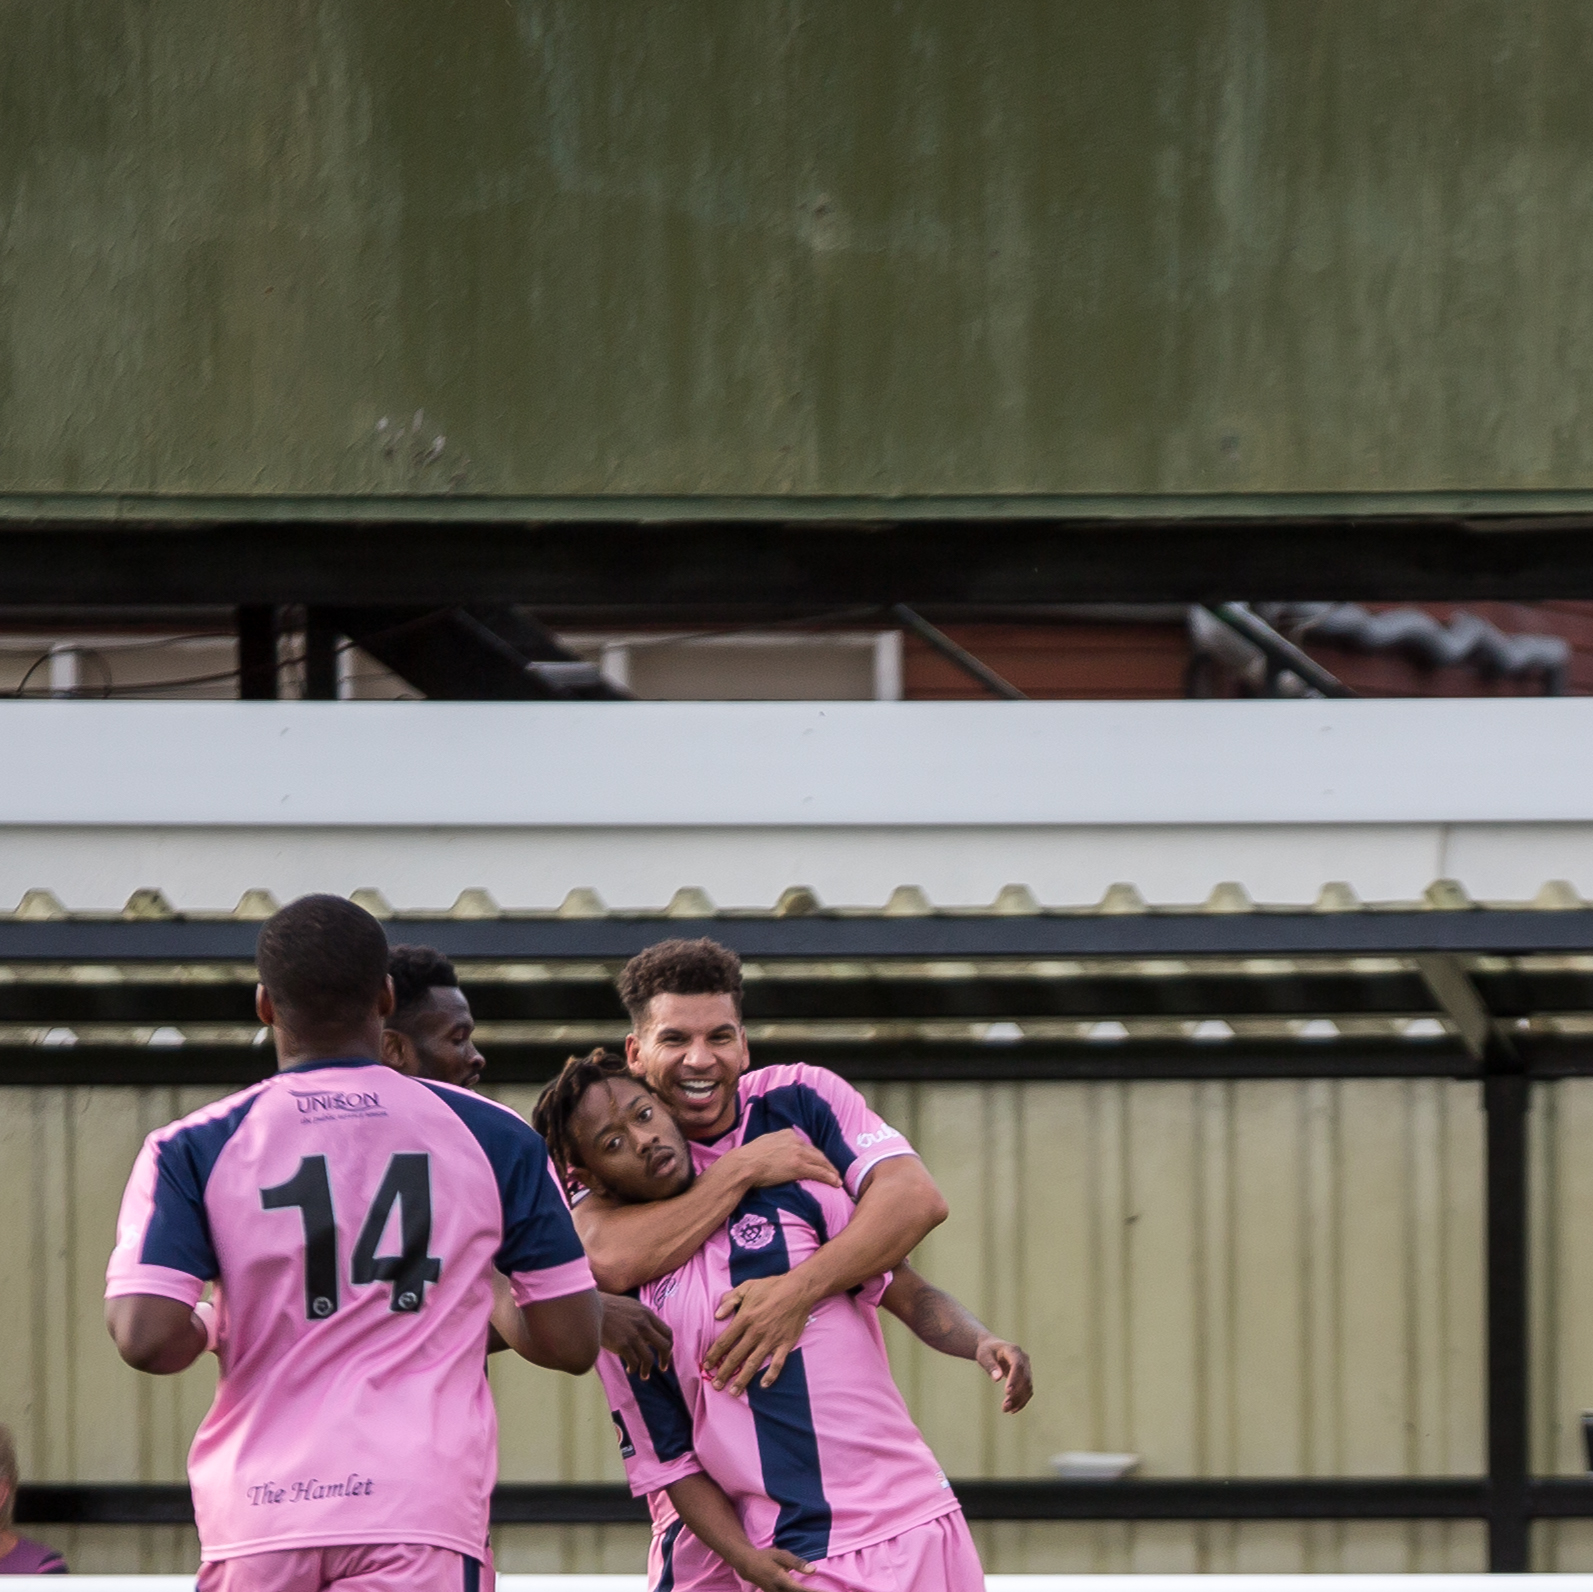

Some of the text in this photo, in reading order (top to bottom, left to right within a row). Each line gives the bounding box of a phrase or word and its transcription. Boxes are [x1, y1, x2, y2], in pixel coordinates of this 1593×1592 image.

[259, 1152, 442, 1320] 14
[246, 1473, 375, 1506] The Hamlet
